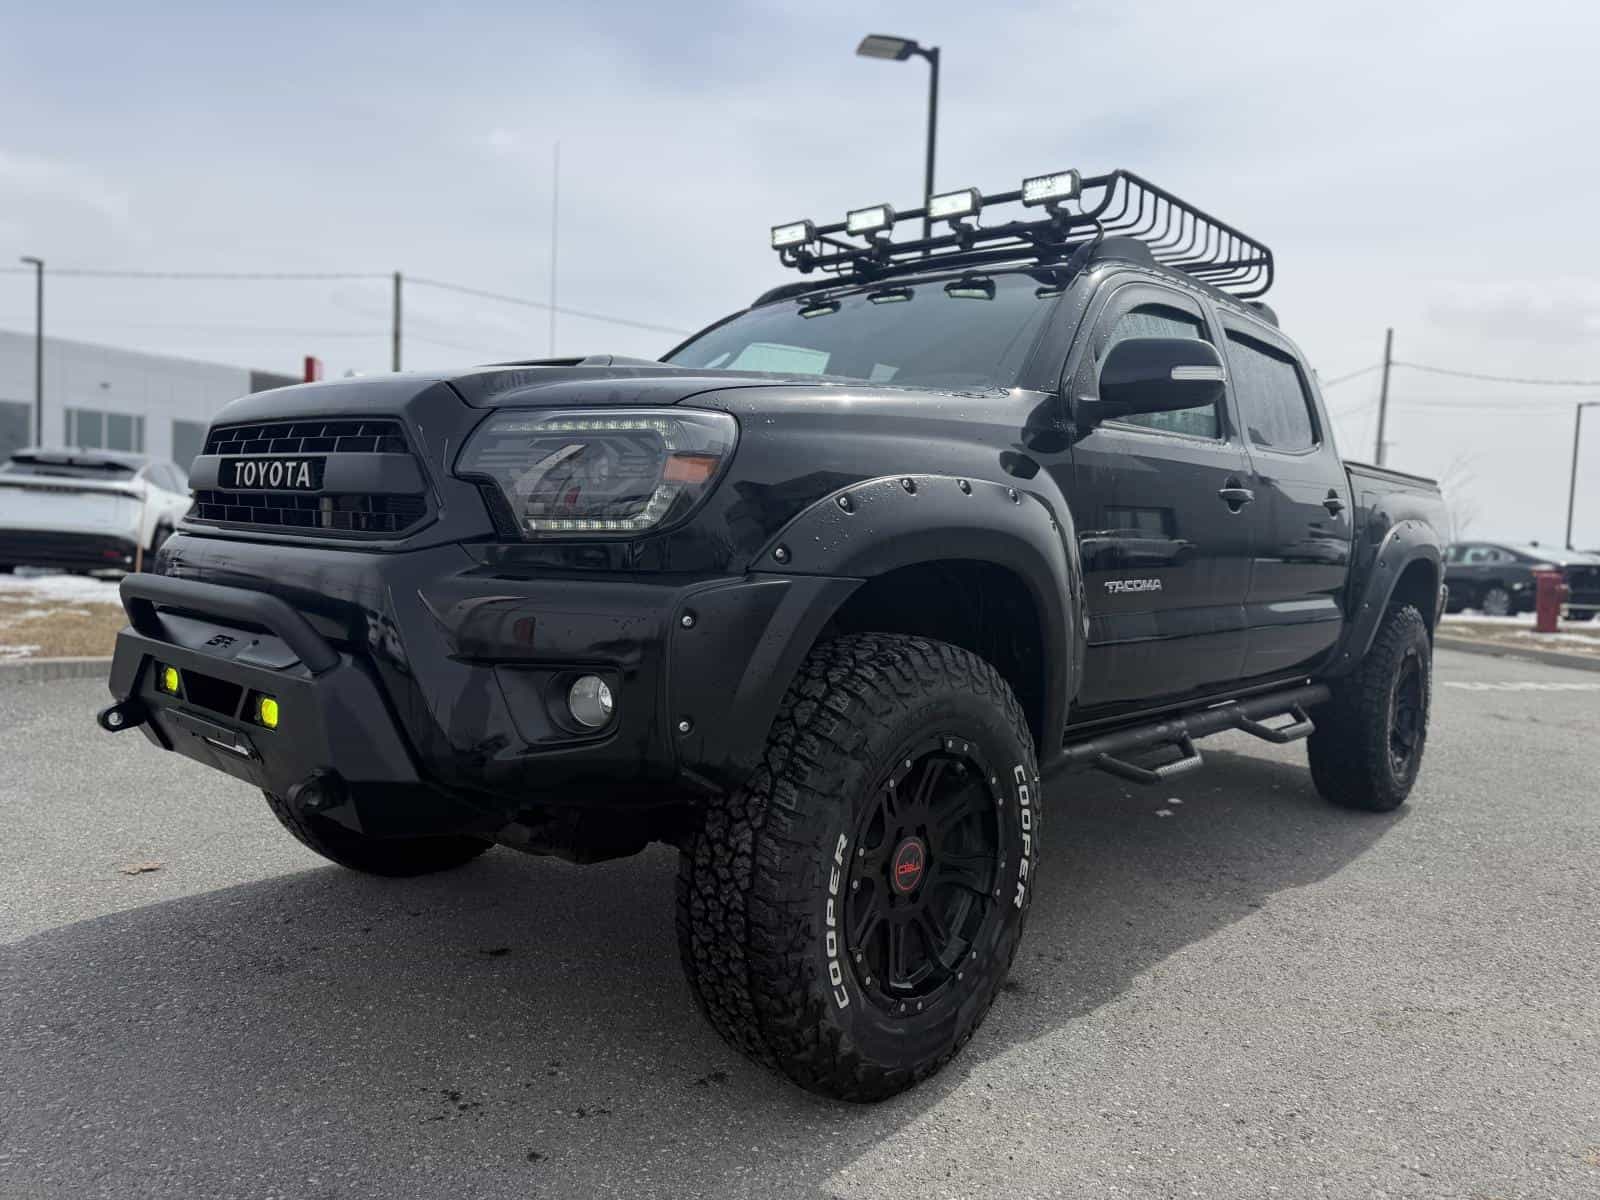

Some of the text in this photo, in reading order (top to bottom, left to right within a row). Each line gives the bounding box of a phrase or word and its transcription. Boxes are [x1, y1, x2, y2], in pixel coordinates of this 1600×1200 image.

[234, 461, 311, 488] TOYOTA
[1104, 579, 1162, 593] TACOMA
[1013, 764, 1031, 909] COOPER
[826, 833, 849, 1009] COOPER
